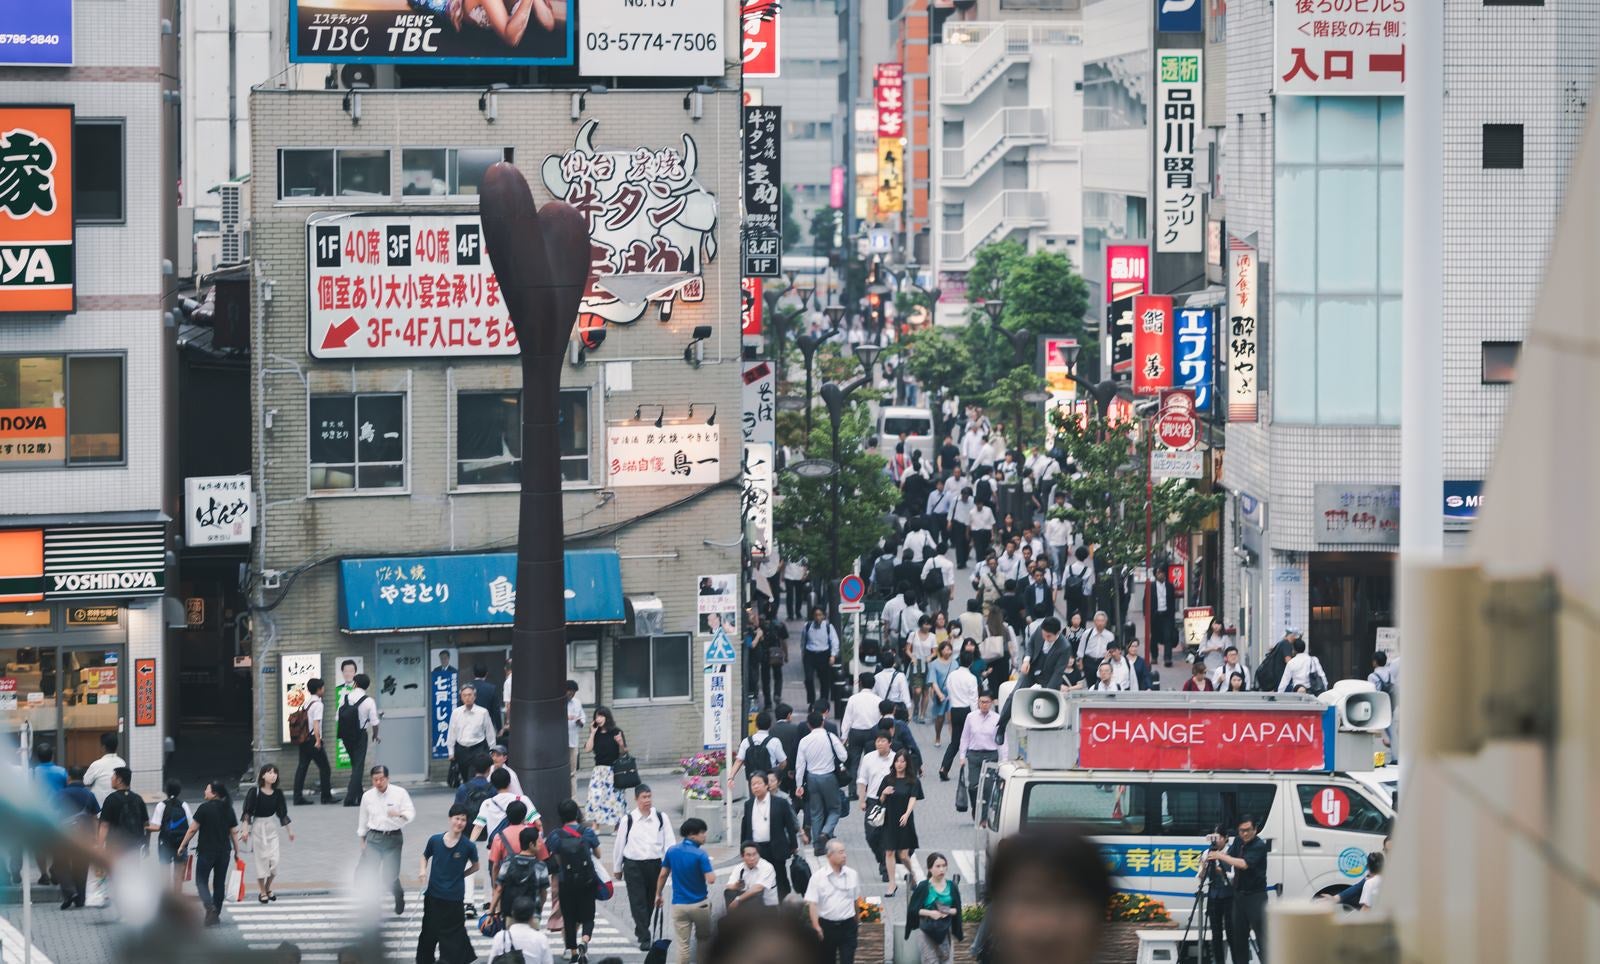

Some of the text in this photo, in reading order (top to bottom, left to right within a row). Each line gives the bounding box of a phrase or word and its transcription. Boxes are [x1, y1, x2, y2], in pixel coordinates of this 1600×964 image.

[313, 14, 368, 24] エステティック
[395, 15, 434, 27] MEN'S
[308, 26, 370, 51] TBC
[387, 28, 441, 52] TBC
[587, 33, 717, 51] 03-5774-7506
[1162, 58, 1197, 82] 透析
[1282, 48, 1354, 83] 入口
[748, 110, 764, 160] 牛タン
[1164, 89, 1196, 189] 品川腎
[569, 180, 684, 228] 牛タン
[318, 235, 339, 259] 1F
[345, 229, 380, 264] 40席
[389, 234, 409, 258] 3F
[415, 228, 449, 263] 40席
[458, 234, 479, 257] 4F
[0, 248, 55, 283] YA
[753, 259, 770, 272] 1F
[1110, 257, 1145, 279] 品川
[1161, 422, 1193, 438] 消火栓
[0, 443, 52, 455] す(12席)
[671, 449, 719, 477] 鳥一
[54, 571, 157, 592] YOSHINOYA
[380, 582, 450, 605] やきとり
[1092, 721, 1315, 744] CHANGE JAPAN
[1126, 848, 1202, 873] 幸福実
